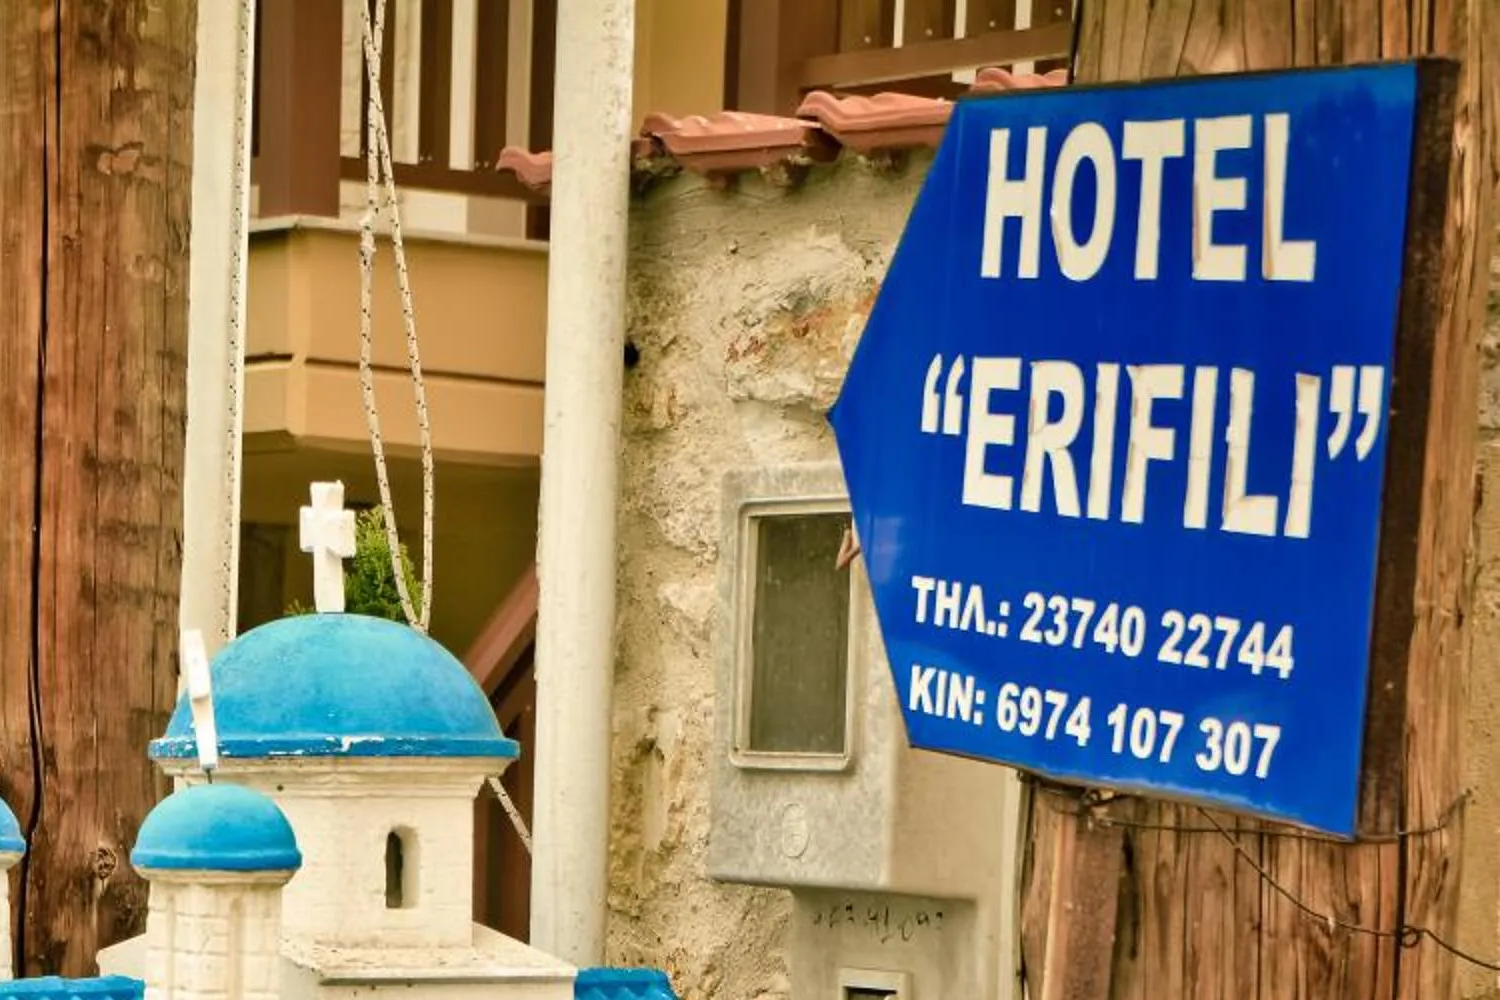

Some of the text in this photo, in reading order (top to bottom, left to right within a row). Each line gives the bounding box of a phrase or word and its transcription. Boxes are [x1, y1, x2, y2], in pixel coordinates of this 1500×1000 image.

[981, 113, 1316, 282] HOTEL
[1019, 591, 1146, 657] 23740
[1157, 609, 1294, 679] 22744
[996, 682, 1091, 747] 6974
[1107, 703, 1184, 763] 107
[1195, 717, 1281, 779] 307
